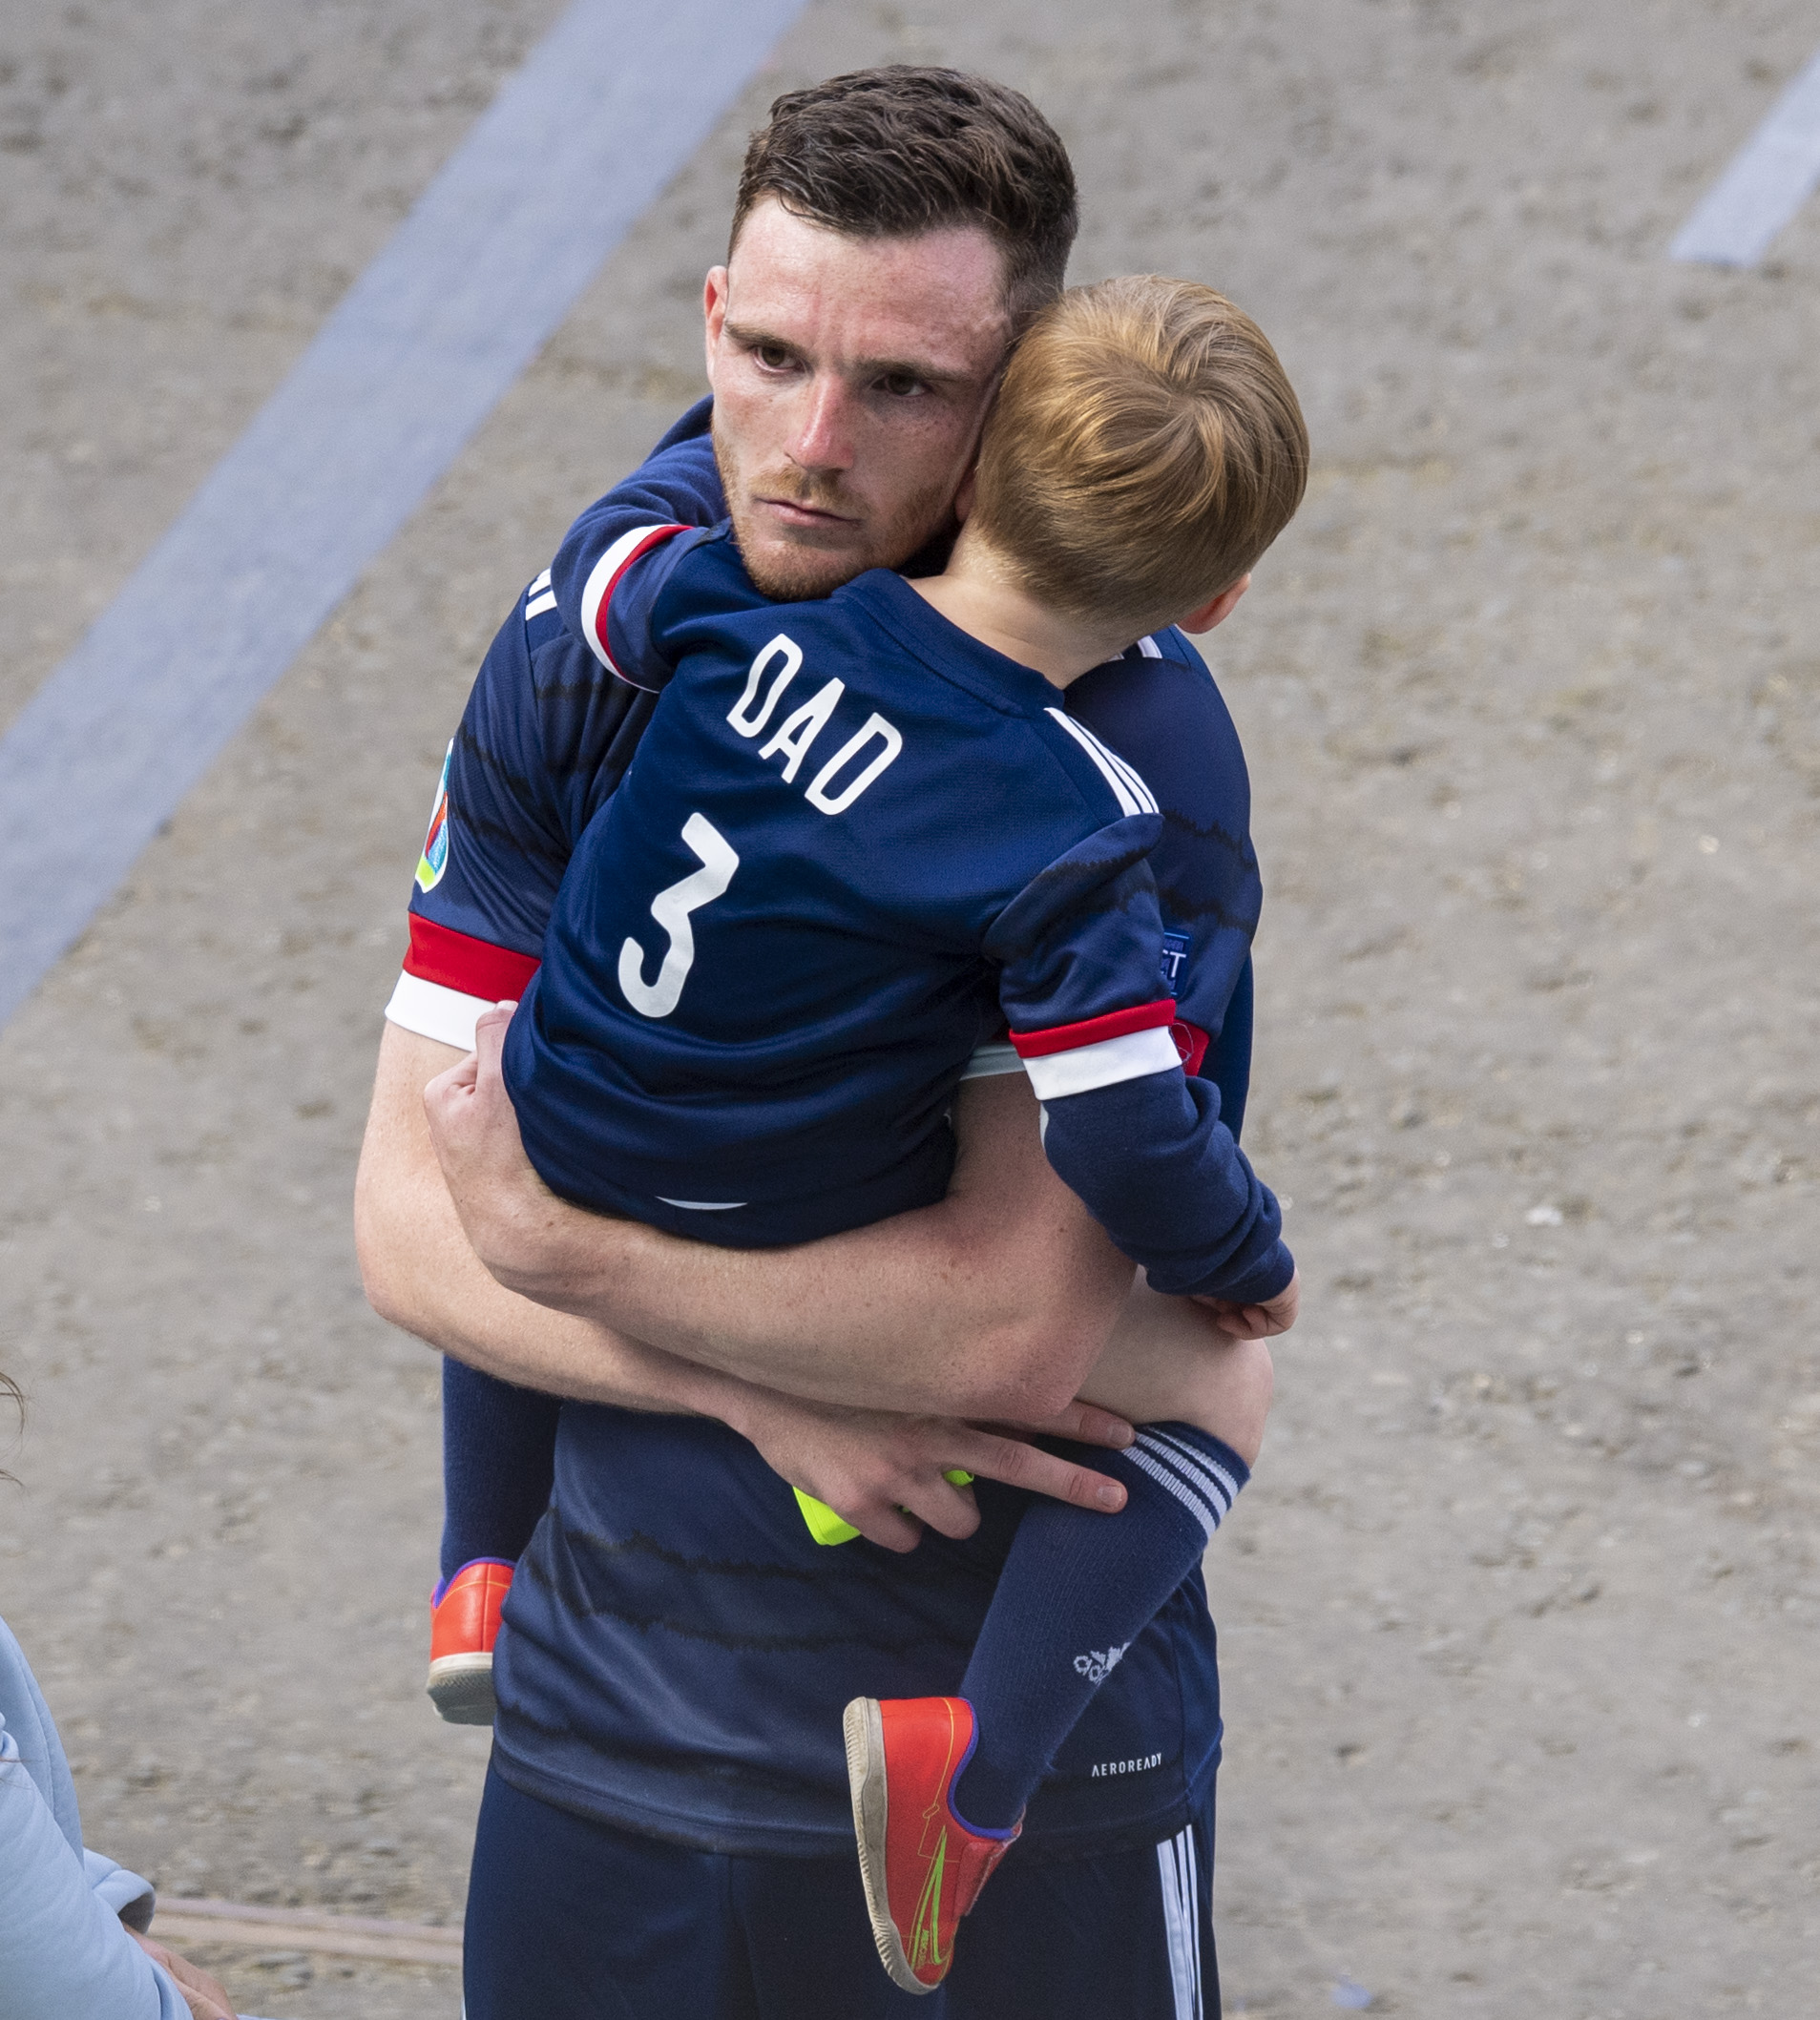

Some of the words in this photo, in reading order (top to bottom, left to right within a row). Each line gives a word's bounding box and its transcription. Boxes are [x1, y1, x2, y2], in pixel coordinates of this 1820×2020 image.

[726, 633, 903, 816] DAD
[618, 812, 739, 1018] 3
[1091, 1752, 1162, 1778] AEROREADY
